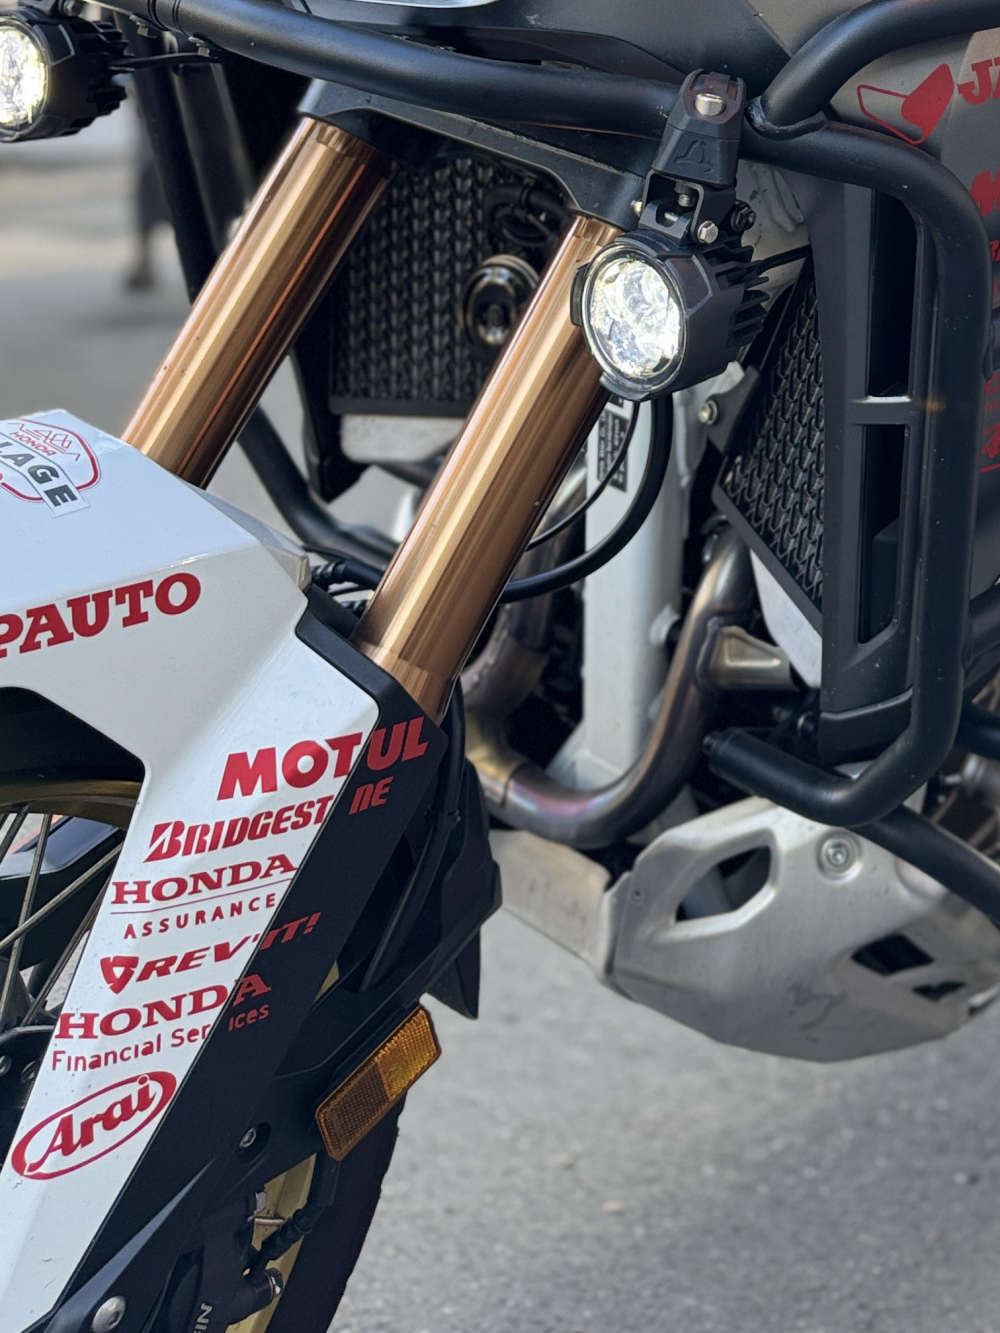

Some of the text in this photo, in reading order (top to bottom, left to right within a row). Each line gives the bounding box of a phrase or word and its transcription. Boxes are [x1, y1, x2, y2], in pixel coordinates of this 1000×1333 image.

[217, 717, 428, 800] MOTUL
[144, 776, 393, 863] BRIDGESTNE
[111, 854, 298, 904] HONDA
[124, 893, 276, 939] ASSURANCE
[52, 1004, 269, 1071] Financial Serices
[55, 974, 271, 1039] HONDA
[26, 1074, 157, 1172] Arai
